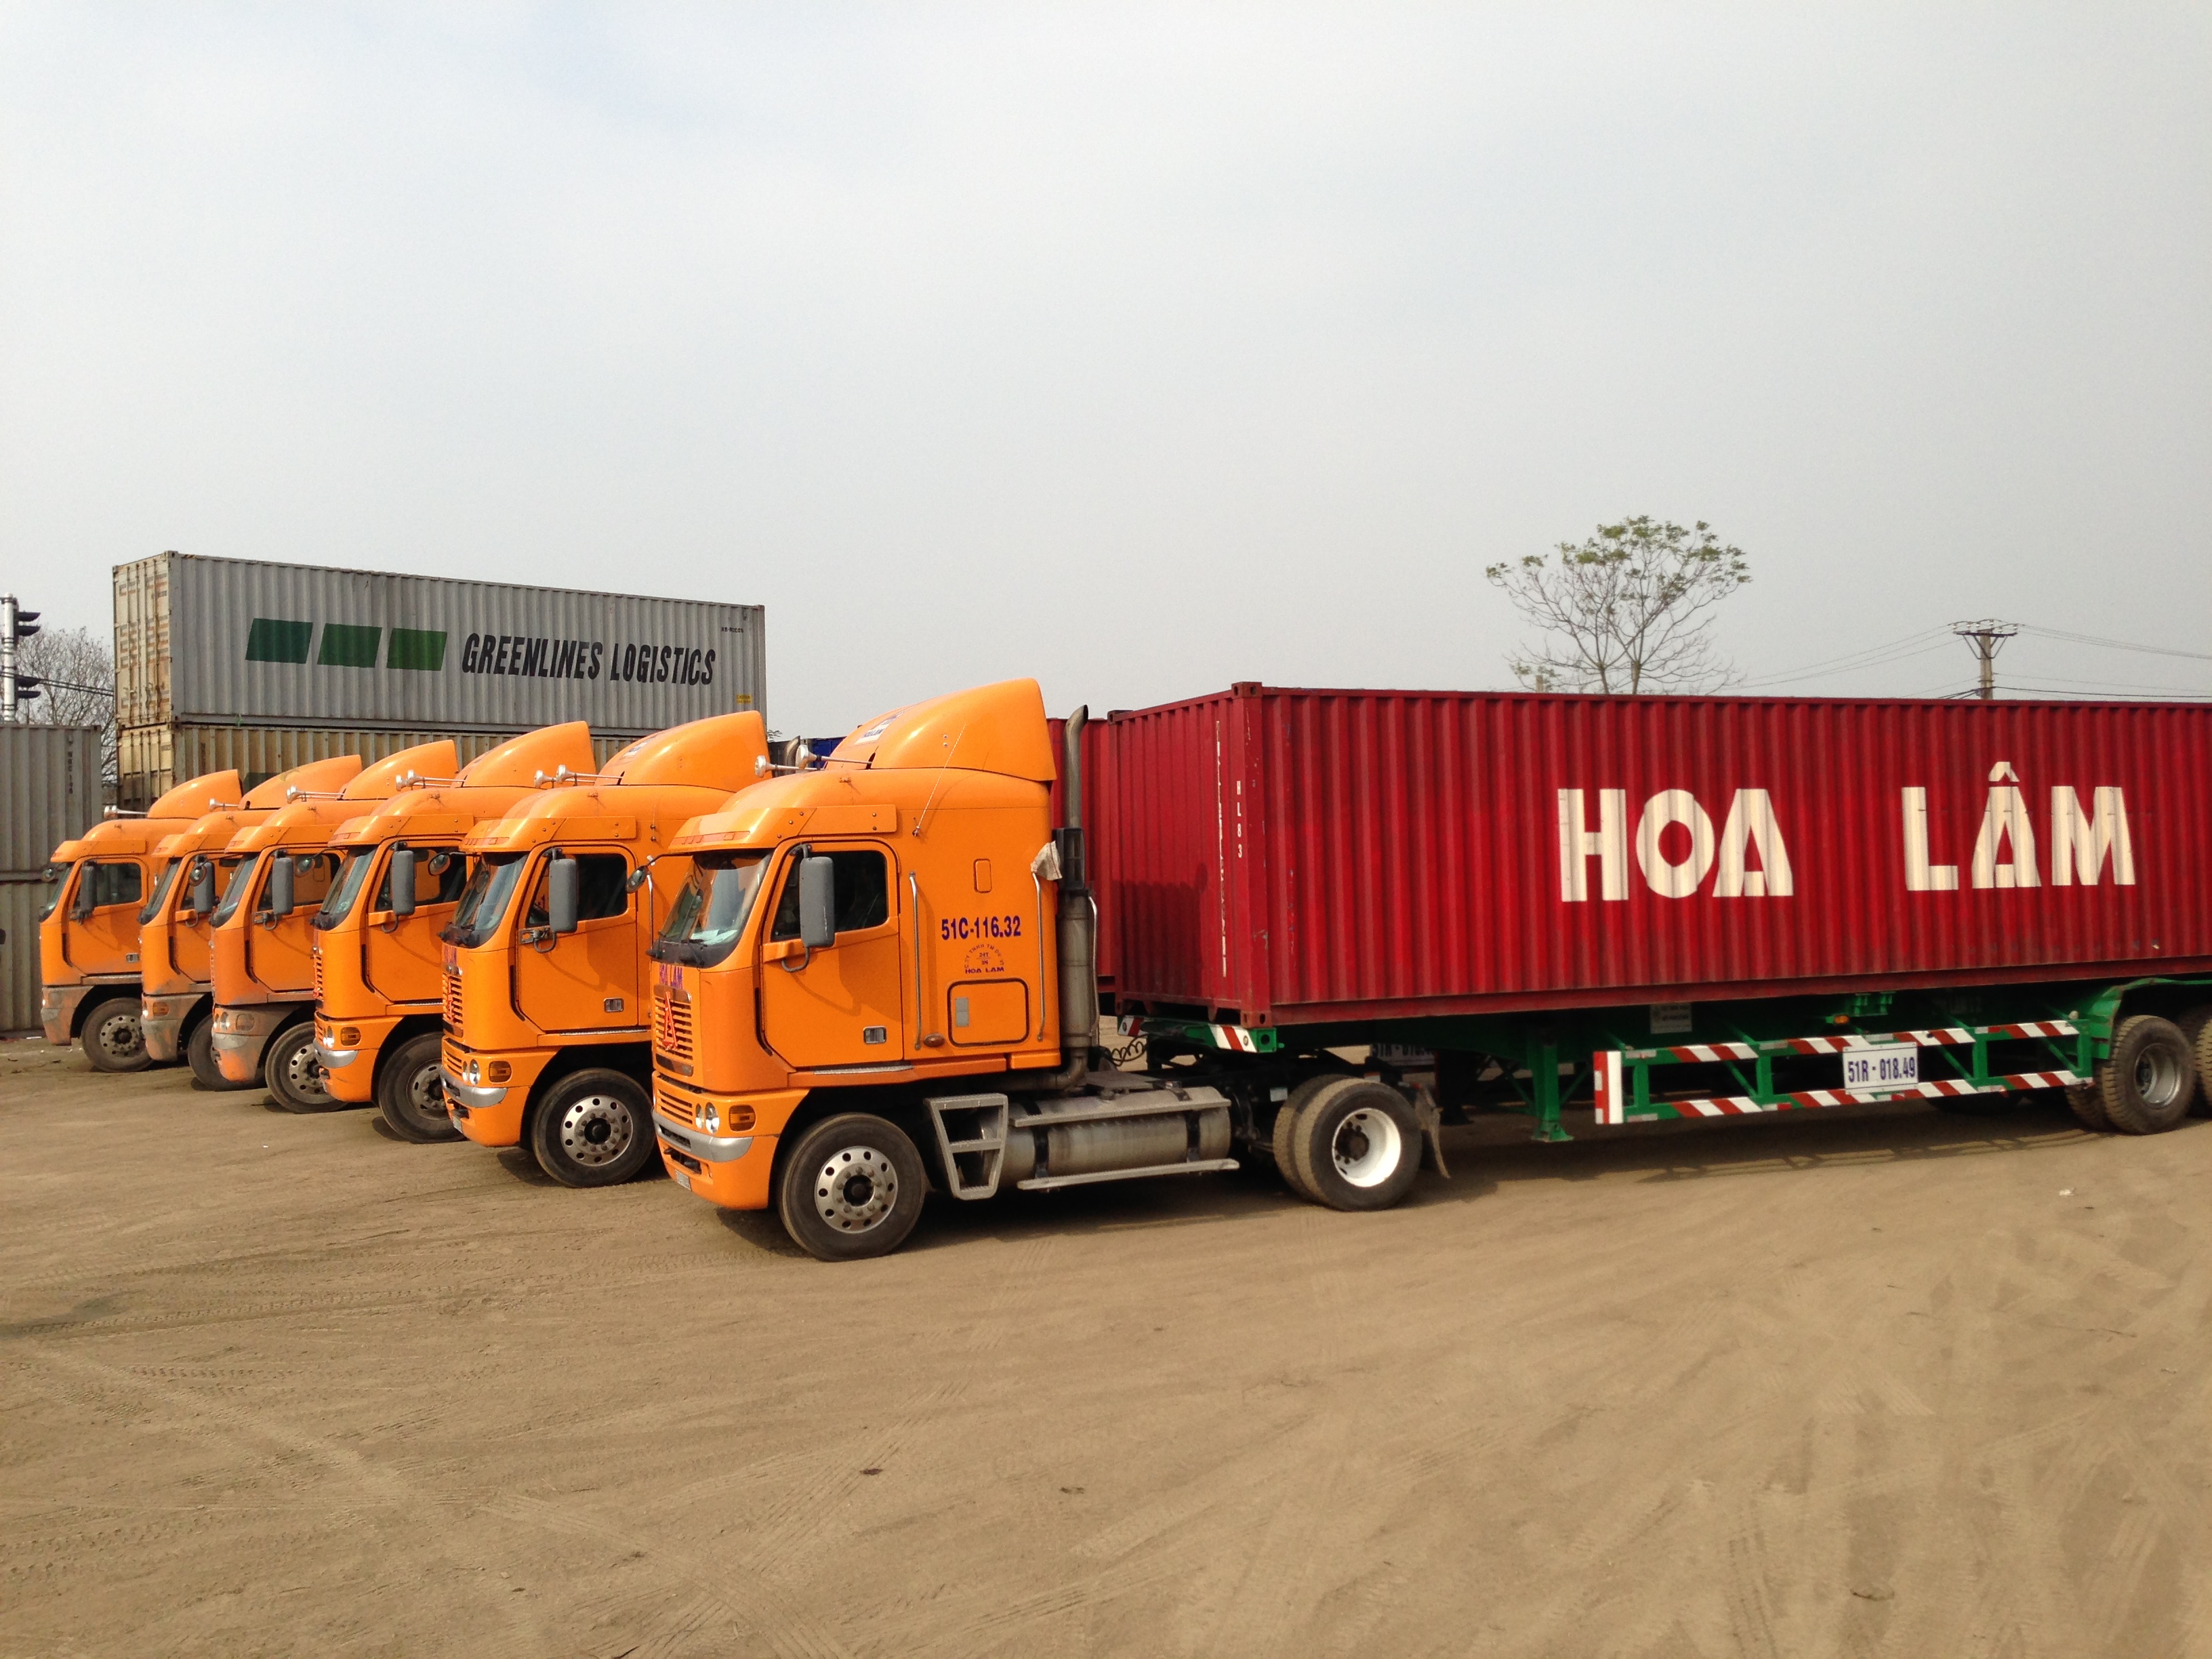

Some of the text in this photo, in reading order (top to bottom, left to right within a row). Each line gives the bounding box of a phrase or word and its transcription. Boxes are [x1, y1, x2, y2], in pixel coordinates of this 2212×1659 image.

[462, 633, 716, 686] GREENLINES LOGISTICS
[1557, 761, 2136, 902] HOA LÂM
[941, 915, 1021, 941] 51C-116.32
